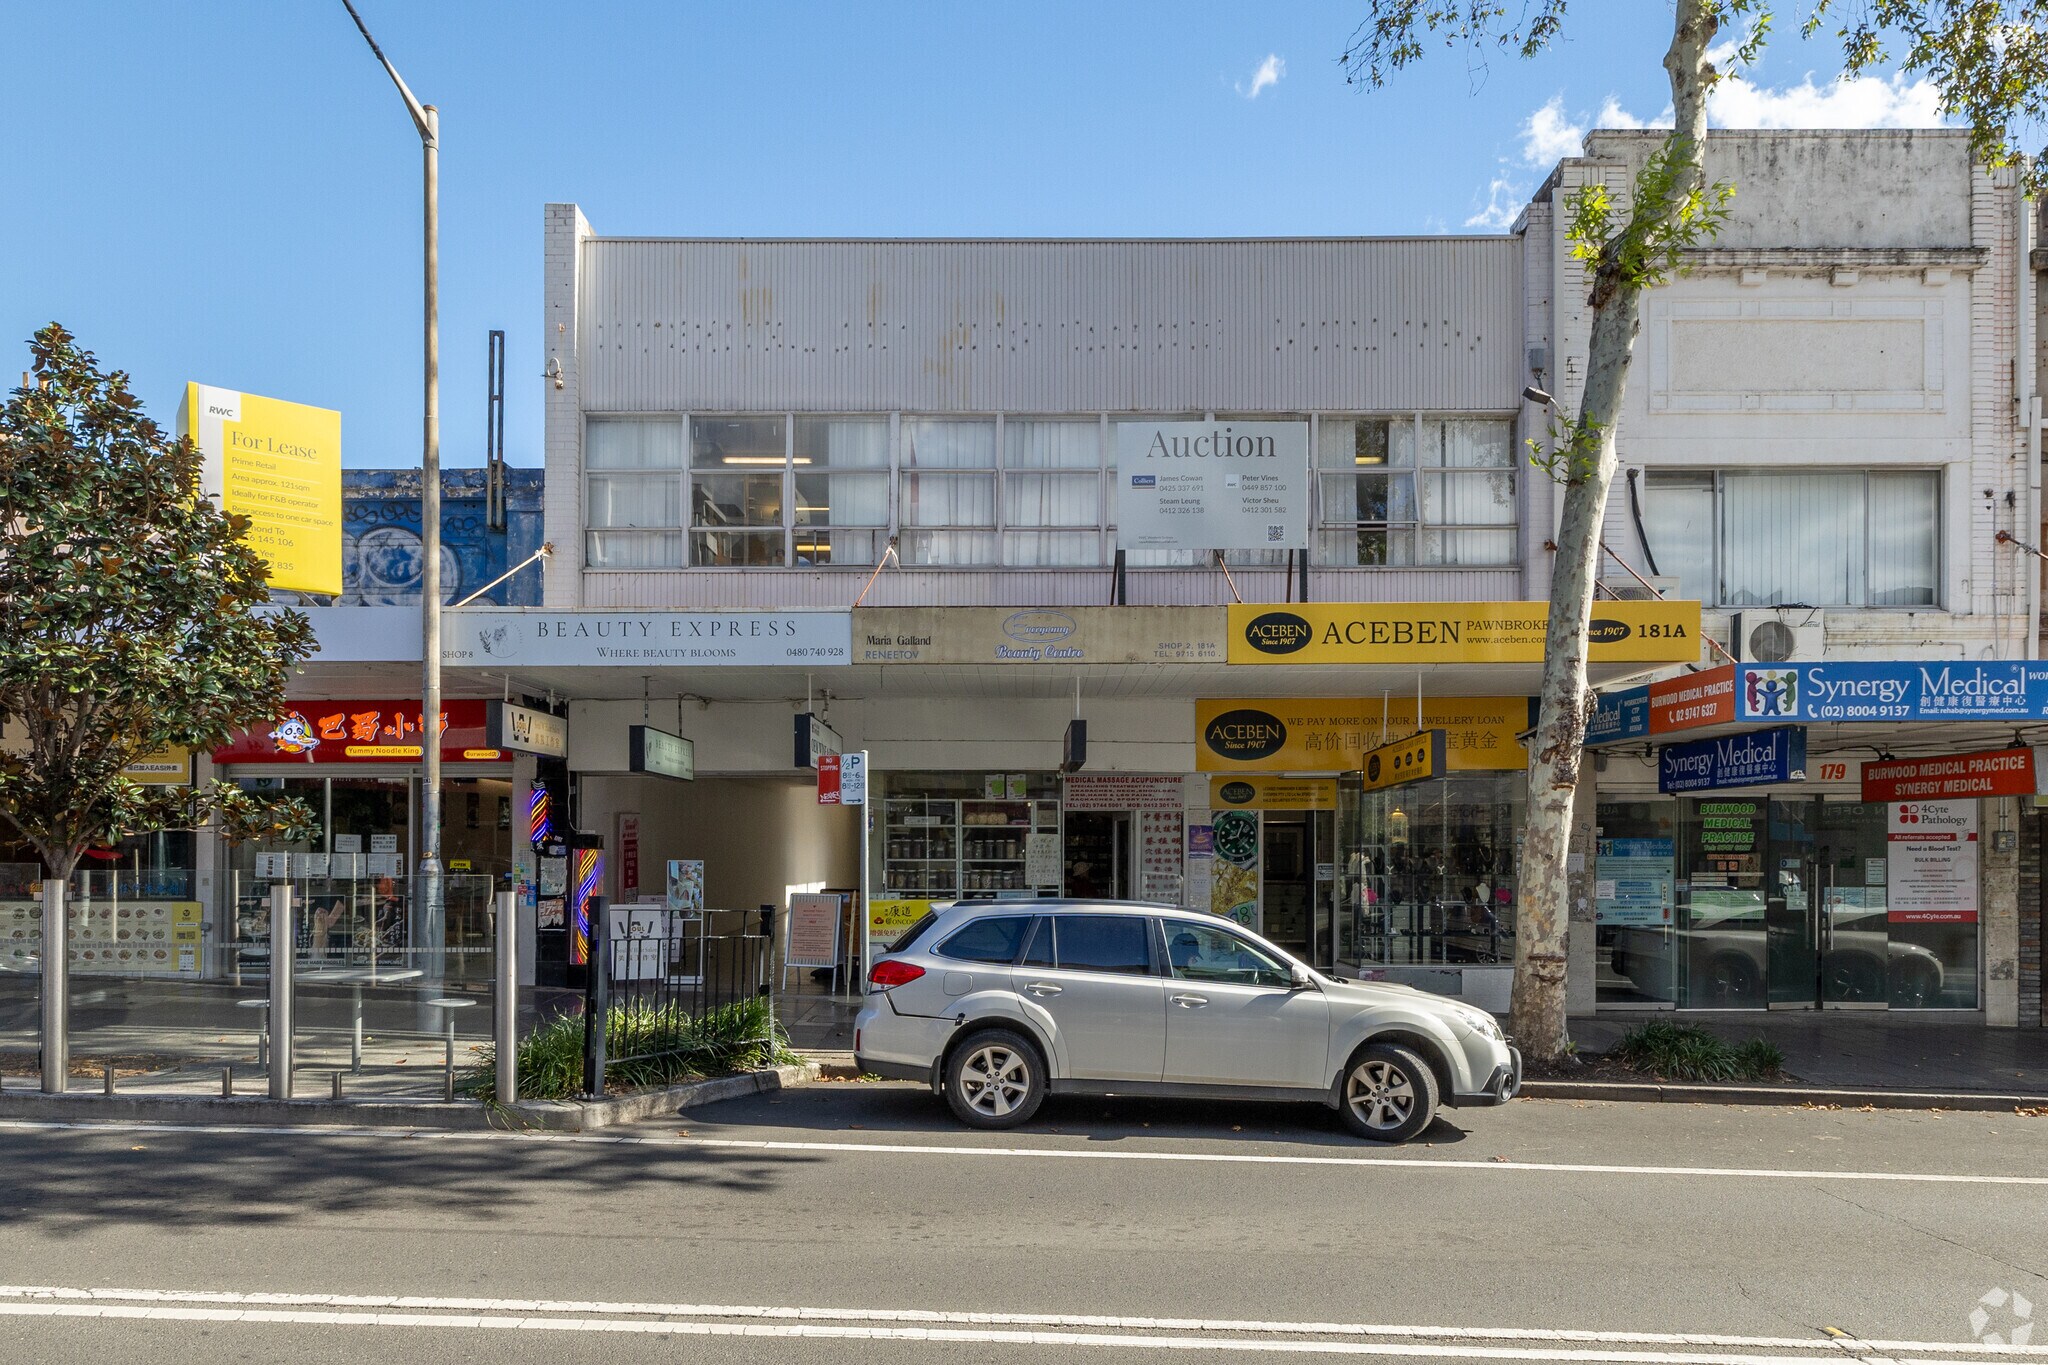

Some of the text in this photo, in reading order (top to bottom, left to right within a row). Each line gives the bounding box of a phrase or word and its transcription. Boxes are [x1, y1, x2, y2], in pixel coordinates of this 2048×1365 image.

[209, 405, 234, 417] RWC
[232, 430, 318, 460] For Lease
[1146, 427, 1277, 458] Auction
[232, 457, 277, 471] Prime Retail
[232, 473, 311, 493] Area approx. 121sqm
[1133, 477, 1155, 485] Colliers
[232, 489, 319, 510] Ideally for F&B operator
[1181, 498, 1200, 506] Leung
[232, 505, 334, 528] Rear access to one car space
[275, 527, 285, 536] To
[258, 535, 275, 544] 145
[278, 538, 294, 547] 106
[259, 549, 275, 558] Yee
[277, 561, 294, 571] 835
[537, 621, 654, 638] BEAUTY
[671, 620, 797, 637] EXPRESS
[1249, 625, 1307, 638] ACEBEN
[1466, 620, 1548, 631] PAWNBROKE
[1603, 626, 1625, 636] 1907
[1638, 623, 1687, 638] 181A
[1322, 621, 1461, 644] ACEBEN
[866, 635, 932, 646] Maria Galland
[1158, 642, 1216, 650] SHOP 181A
[1261, 637, 1296, 646] Since 1907
[442, 651, 474, 659] SHOP 8
[643, 648, 688, 658] BEAUTY
[690, 648, 736, 658] BLOOMS
[786, 648, 844, 657] 0480 740 928
[995, 645, 1084, 661] Beauty Centre
[1153, 650, 1216, 658] TEL: 9715 6110
[1807, 666, 2026, 702] Synergy Medical
[1651, 680, 1734, 708] BURWOOD MEDICAL PRACTICE
[1676, 703, 1717, 722] 02 9747 6327
[1820, 705, 1910, 718] (02) 8004 9137
[1940, 707, 2029, 715] rehab@synergymed.com.au
[1287, 716, 1505, 726] WE PAY MORE ON YOUR JEWELLERY LOAN
[1210, 724, 1281, 740] ACEBEN
[1224, 740, 1267, 749] Since 1907
[348, 747, 375, 755] Yummy
[403, 747, 419, 755] King
[1665, 732, 1776, 778] Synergy Medical
[1819, 763, 1846, 780] 179
[1868, 756, 2026, 781] BURWOOD MEDICAL PRACTICE
[1667, 778, 1710, 789] Tel: (02) 8004 9137
[1895, 778, 1993, 796] SYNERGY MEDICAL
[1222, 787, 1253, 796] ACEBEN
[1700, 803, 1757, 815] BURWOOD
[1921, 804, 1949, 815] 4Cyte
[1703, 817, 1753, 829] MEDICAL
[1921, 814, 1968, 827] Pathology
[1701, 831, 1756, 844] PRACTICE
